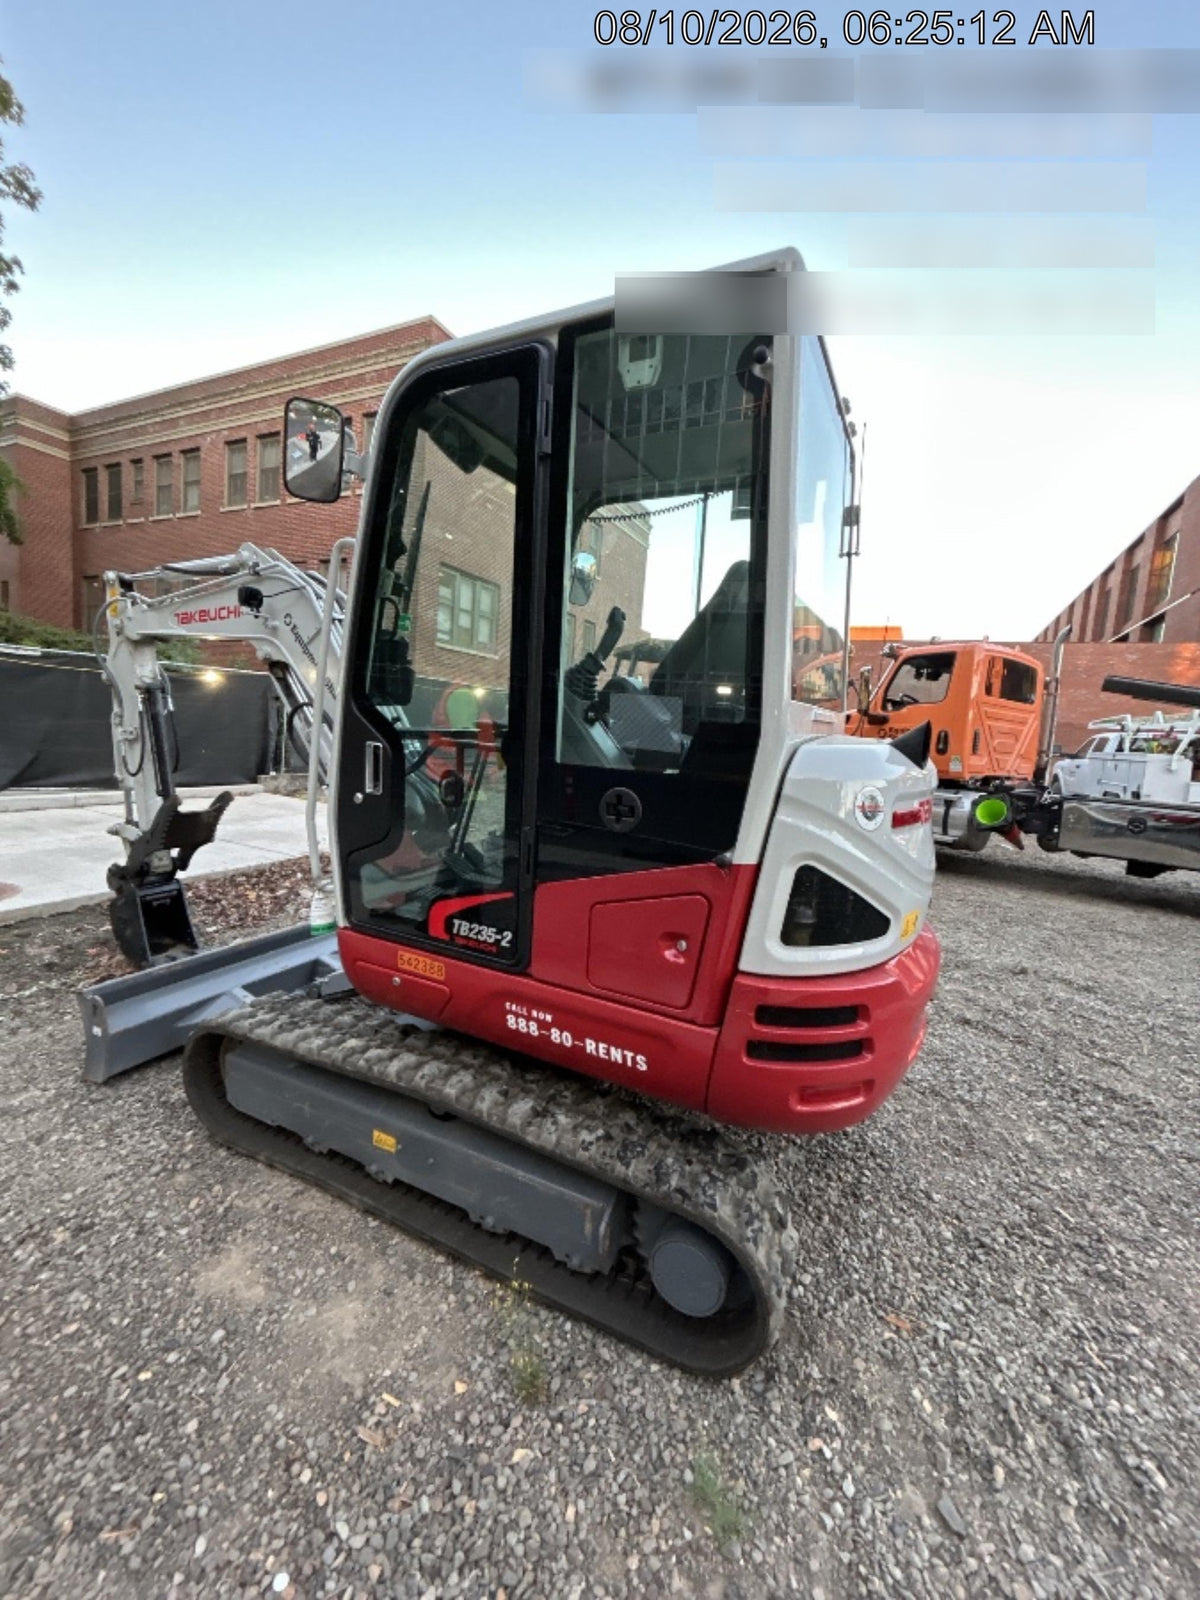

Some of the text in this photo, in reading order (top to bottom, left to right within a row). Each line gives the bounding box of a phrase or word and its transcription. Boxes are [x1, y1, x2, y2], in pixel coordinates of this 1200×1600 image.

[452, 918, 513, 947] TB235-2
[504, 1001, 553, 1023] CALL NOW
[505, 1014, 648, 1071] 888-80-RENTS
